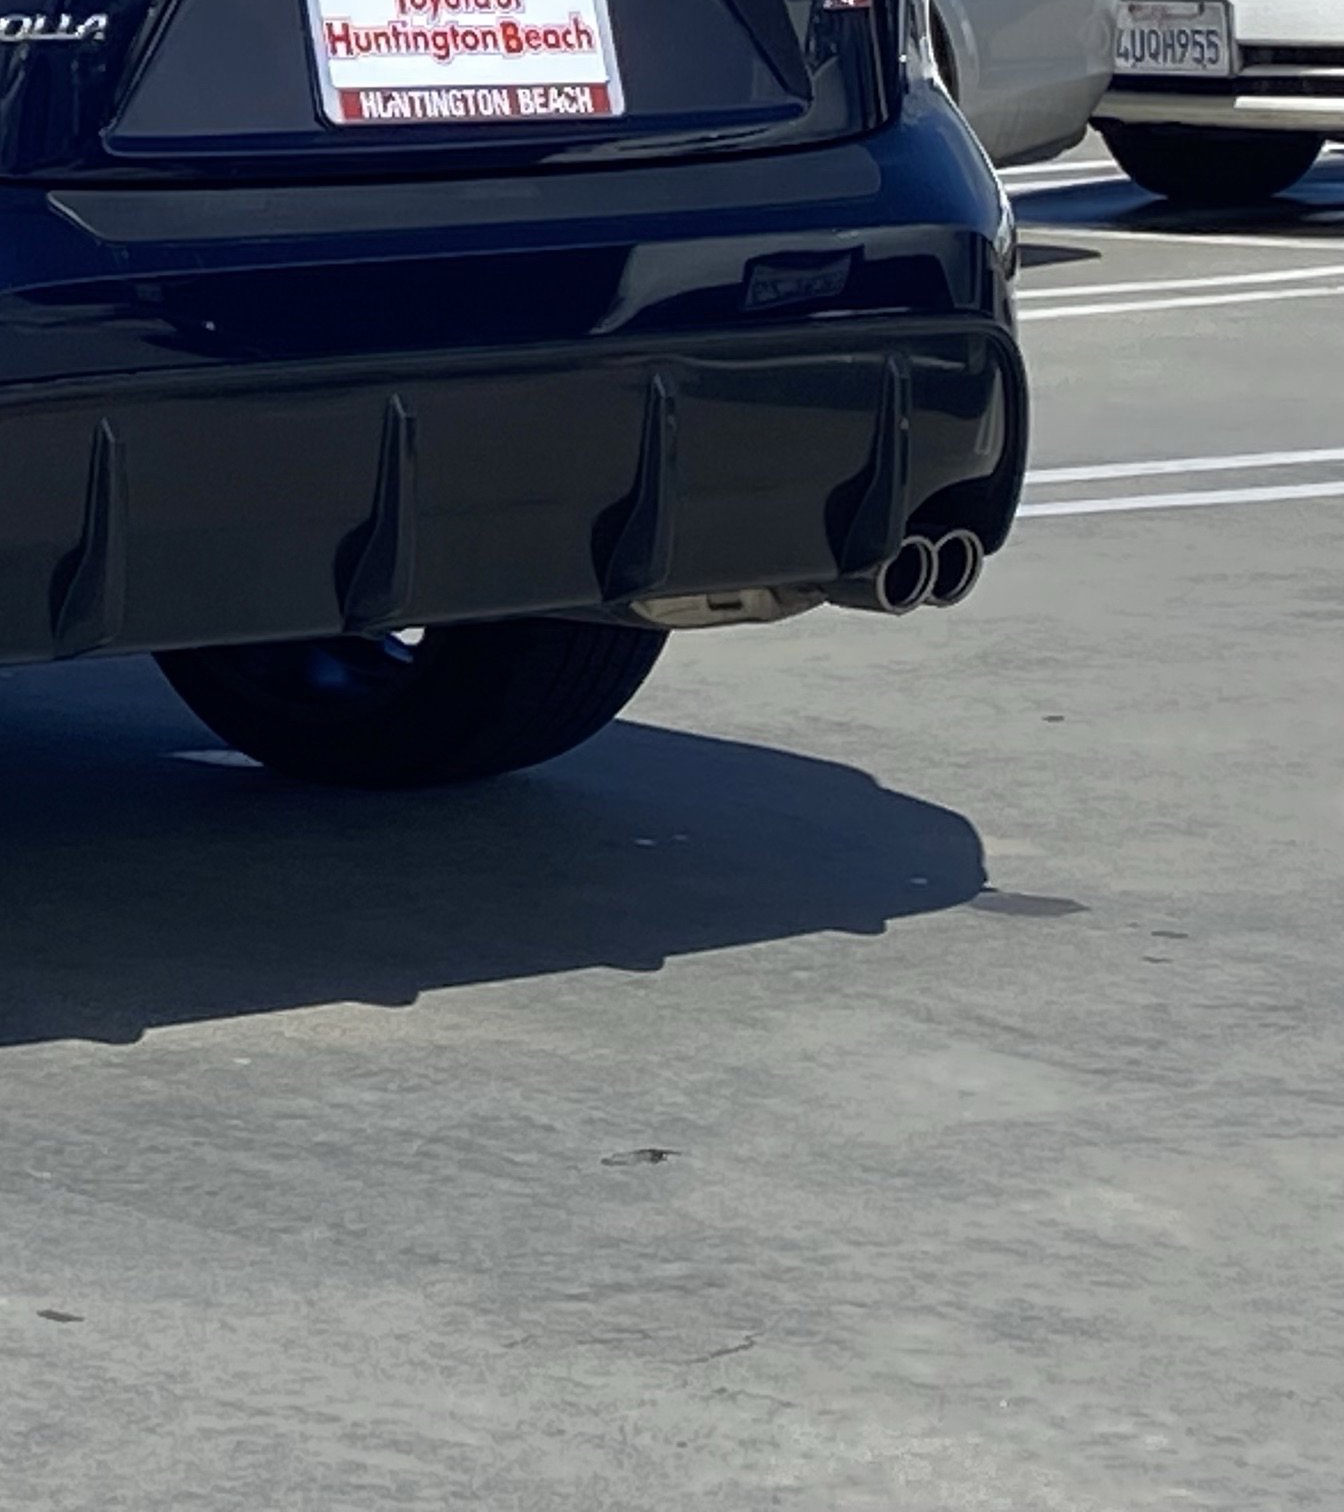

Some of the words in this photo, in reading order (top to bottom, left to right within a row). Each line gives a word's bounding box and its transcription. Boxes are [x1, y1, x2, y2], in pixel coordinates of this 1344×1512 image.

[324, 21, 499, 61] Huntington
[500, 17, 594, 54] Beach
[1116, 29, 1220, 65] 4UQH955
[360, 88, 511, 118] HUNTINGTON
[516, 86, 594, 115] BEACH
